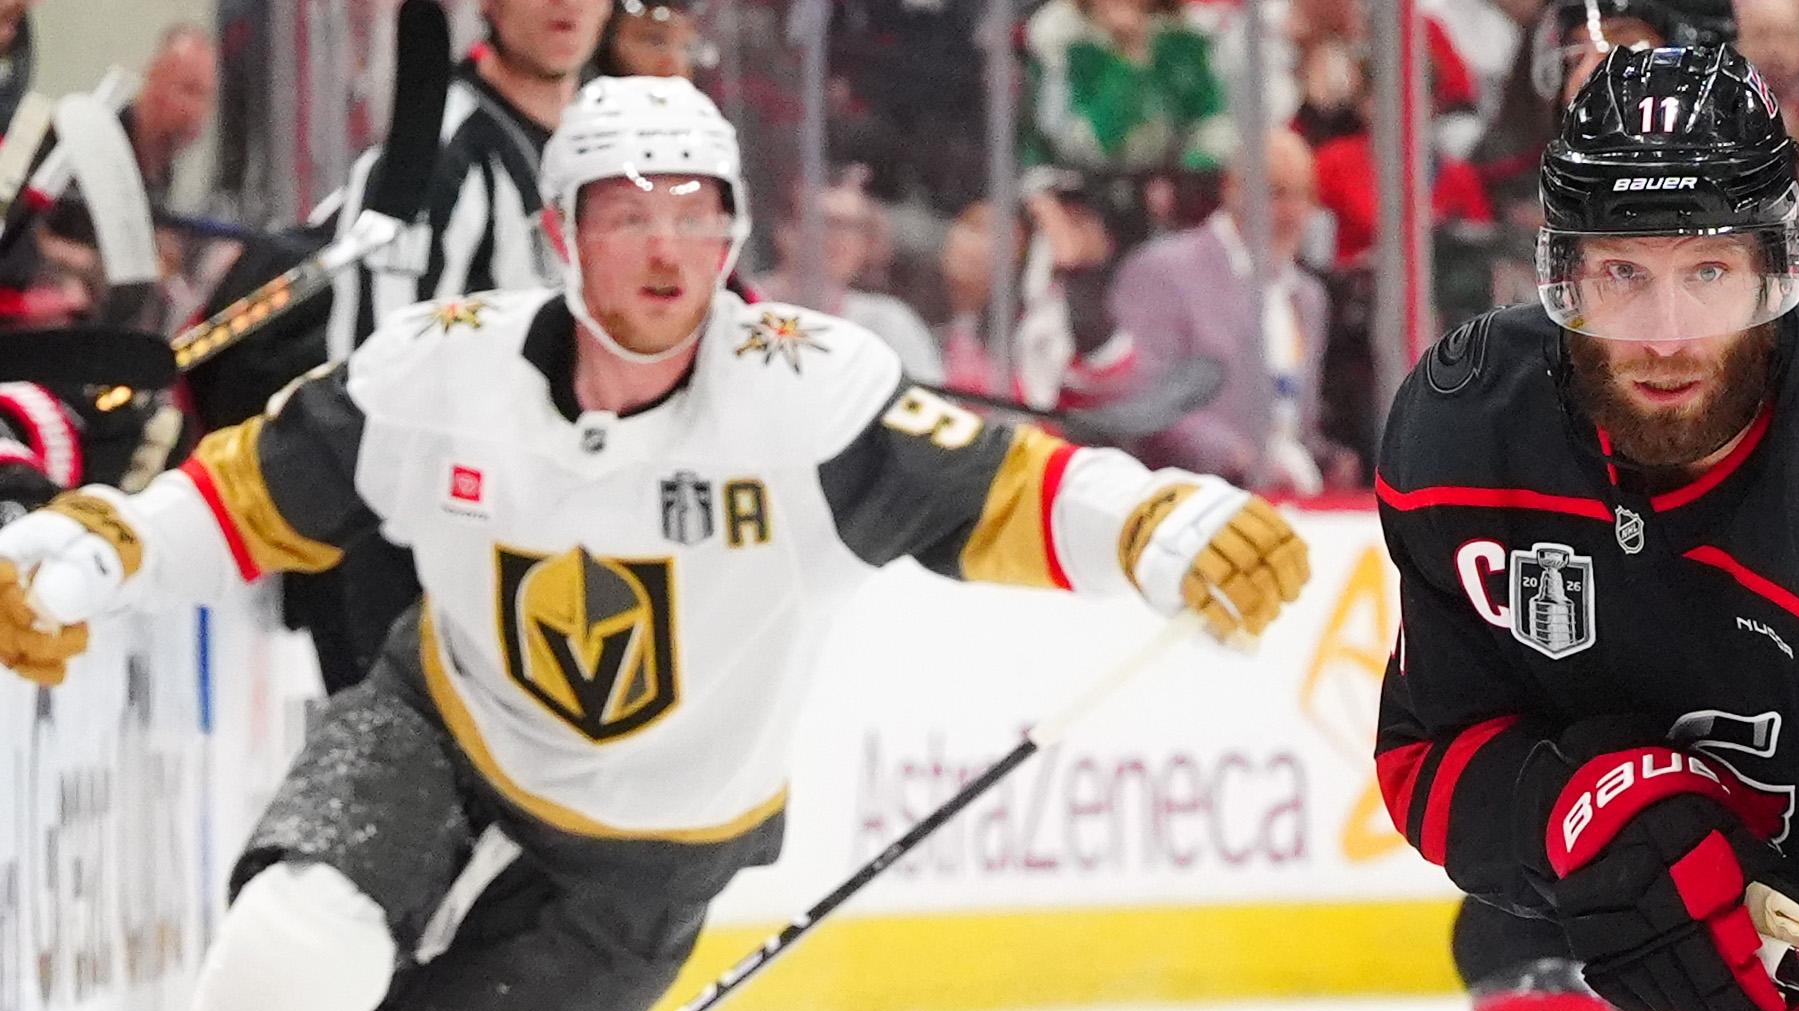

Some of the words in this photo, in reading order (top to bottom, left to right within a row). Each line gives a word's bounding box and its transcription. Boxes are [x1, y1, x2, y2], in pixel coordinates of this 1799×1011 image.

[1638, 96, 1680, 134] 11
[1612, 176, 1699, 192] BAUER
[722, 477, 774, 548] A
[1620, 521, 1640, 541] NHL
[1454, 537, 1512, 629] C
[1522, 576, 1538, 588] 20
[1566, 580, 1582, 592] 26
